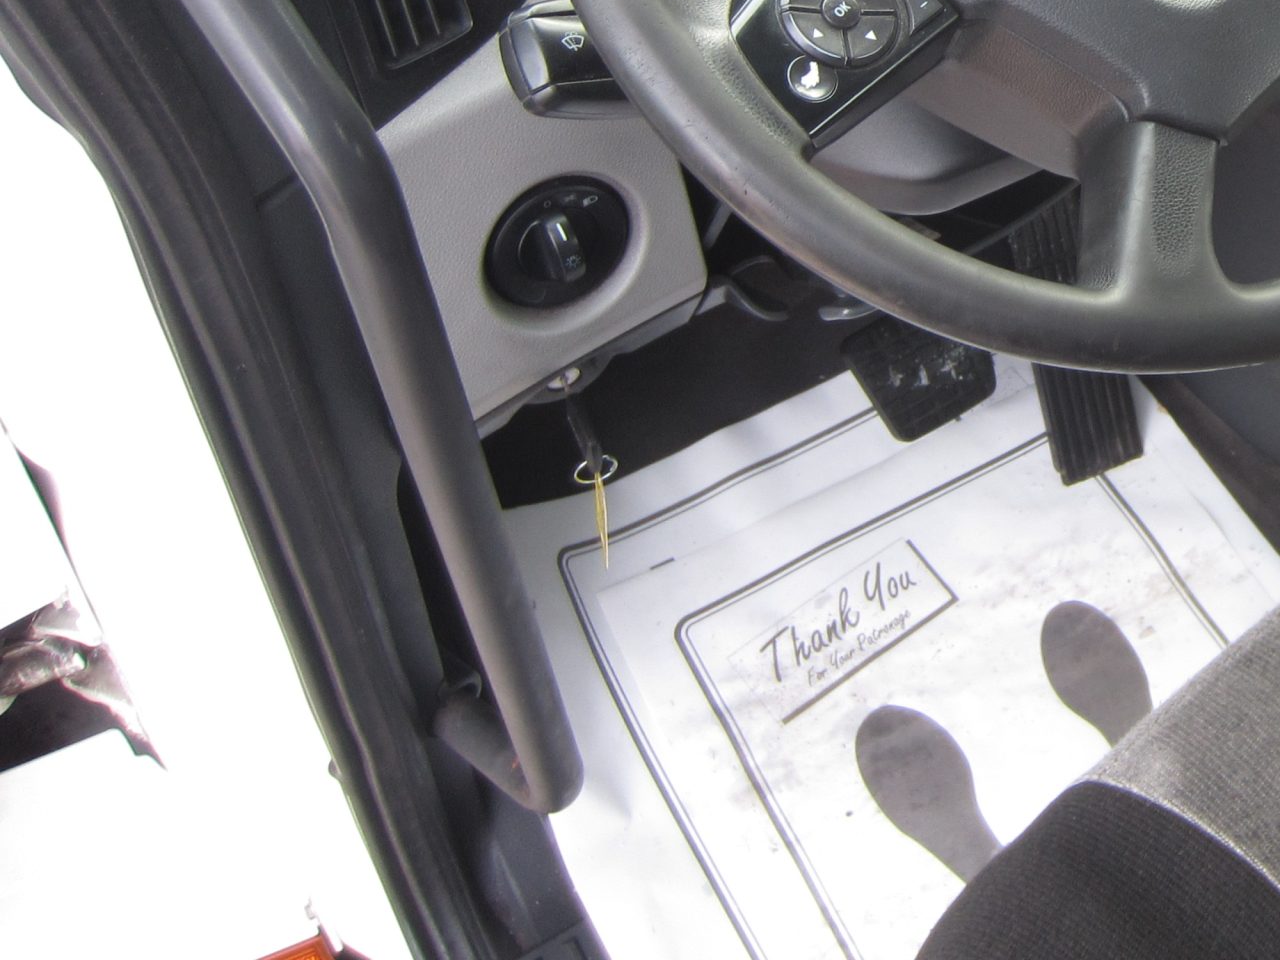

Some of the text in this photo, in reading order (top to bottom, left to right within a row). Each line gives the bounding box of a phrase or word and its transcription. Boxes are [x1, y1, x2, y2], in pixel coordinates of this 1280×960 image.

[834, 1, 851, 17] OK
[759, 561, 918, 683] Thank You
[807, 609, 912, 687] For Your Patronage
